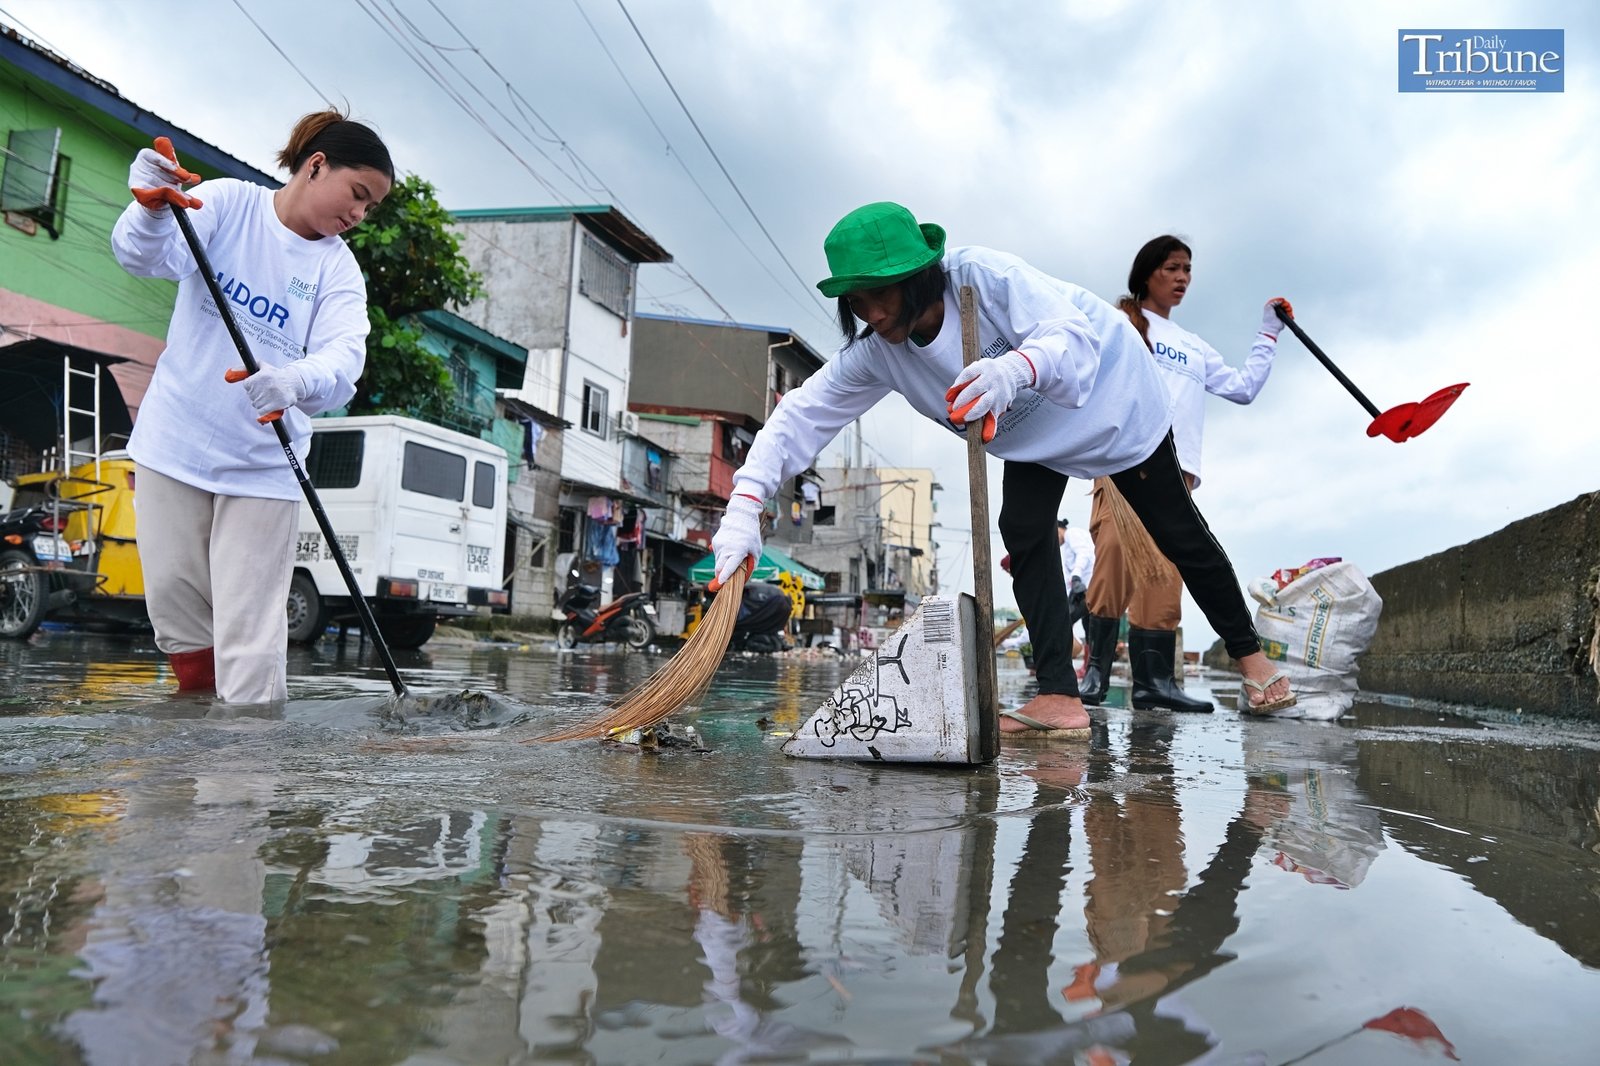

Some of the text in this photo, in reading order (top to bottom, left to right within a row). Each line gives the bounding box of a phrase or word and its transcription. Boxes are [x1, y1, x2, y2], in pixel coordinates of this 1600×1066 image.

[984, 336, 1005, 358] FUND
[1156, 342, 1187, 365] DOR
[296, 542, 319, 553] 342
[467, 552, 489, 565] 1342
[1310, 602, 1330, 645] FINISHE
